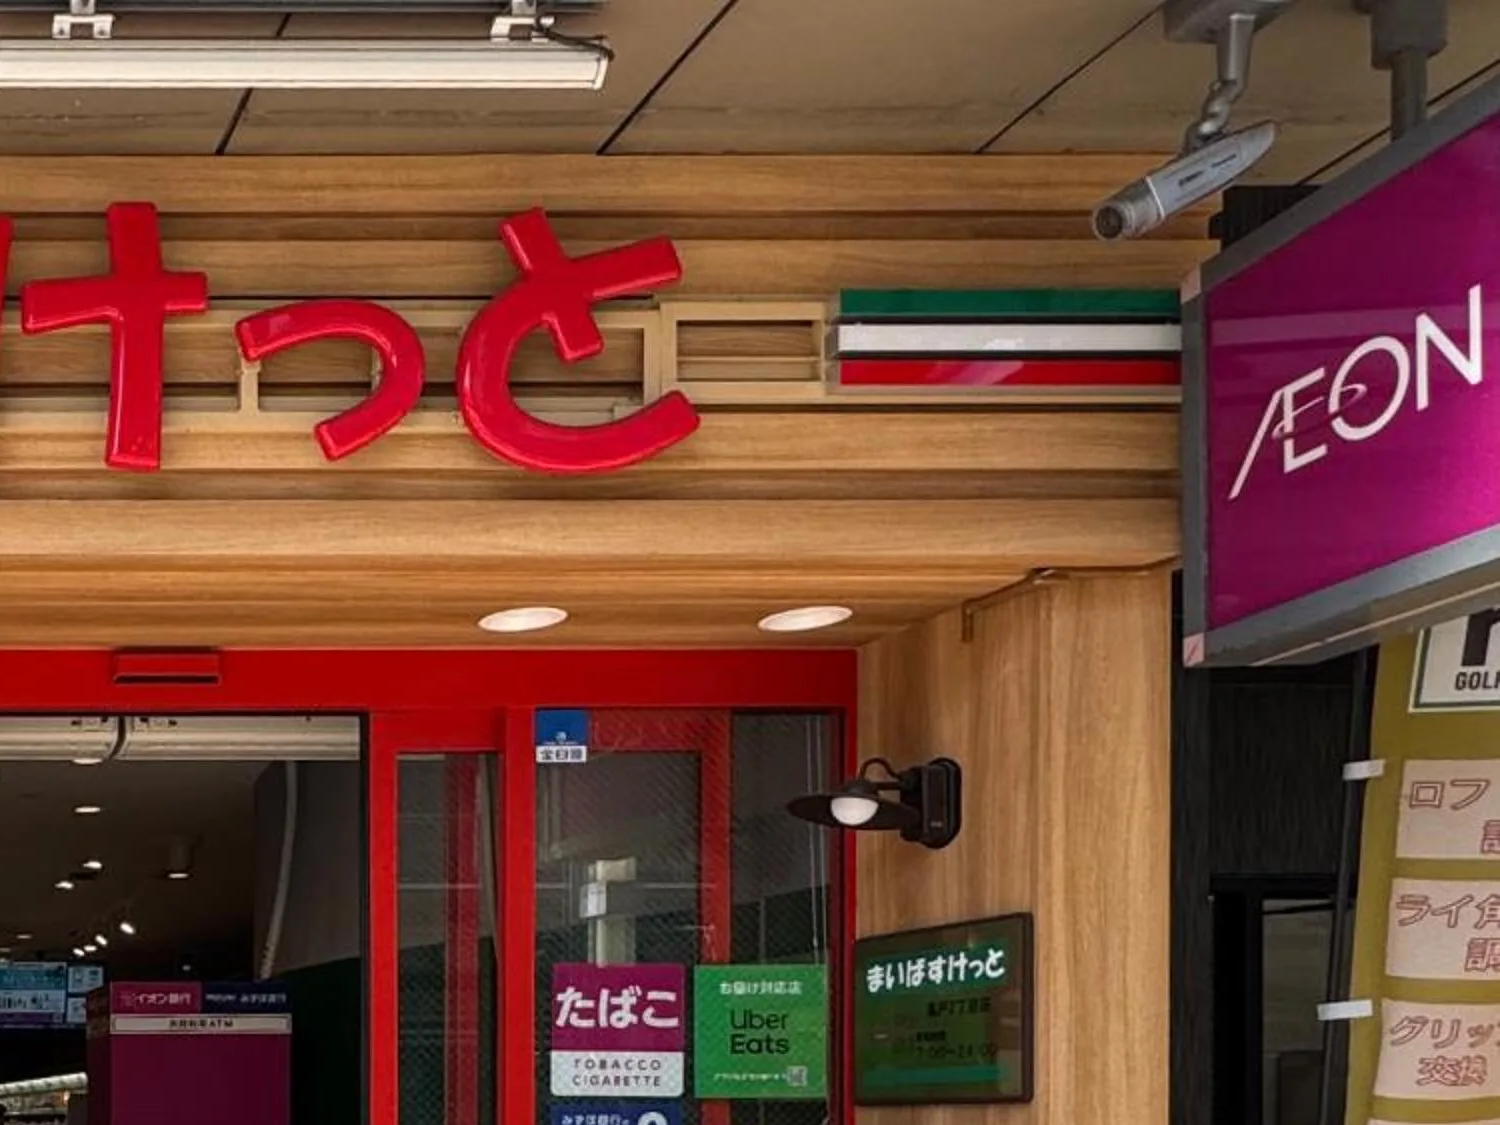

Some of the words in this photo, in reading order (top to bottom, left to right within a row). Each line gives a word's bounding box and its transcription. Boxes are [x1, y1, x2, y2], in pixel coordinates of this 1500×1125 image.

[866, 948, 1006, 993] まいばすけっと
[555, 984, 679, 1029] たばこ
[730, 1009, 789, 1030] Uber
[1389, 1015, 1500, 1049] グリッ
[730, 1033, 791, 1055] Eats
[574, 1059, 661, 1070] TOBACCO
[572, 1075, 661, 1087] CIGARETTE
